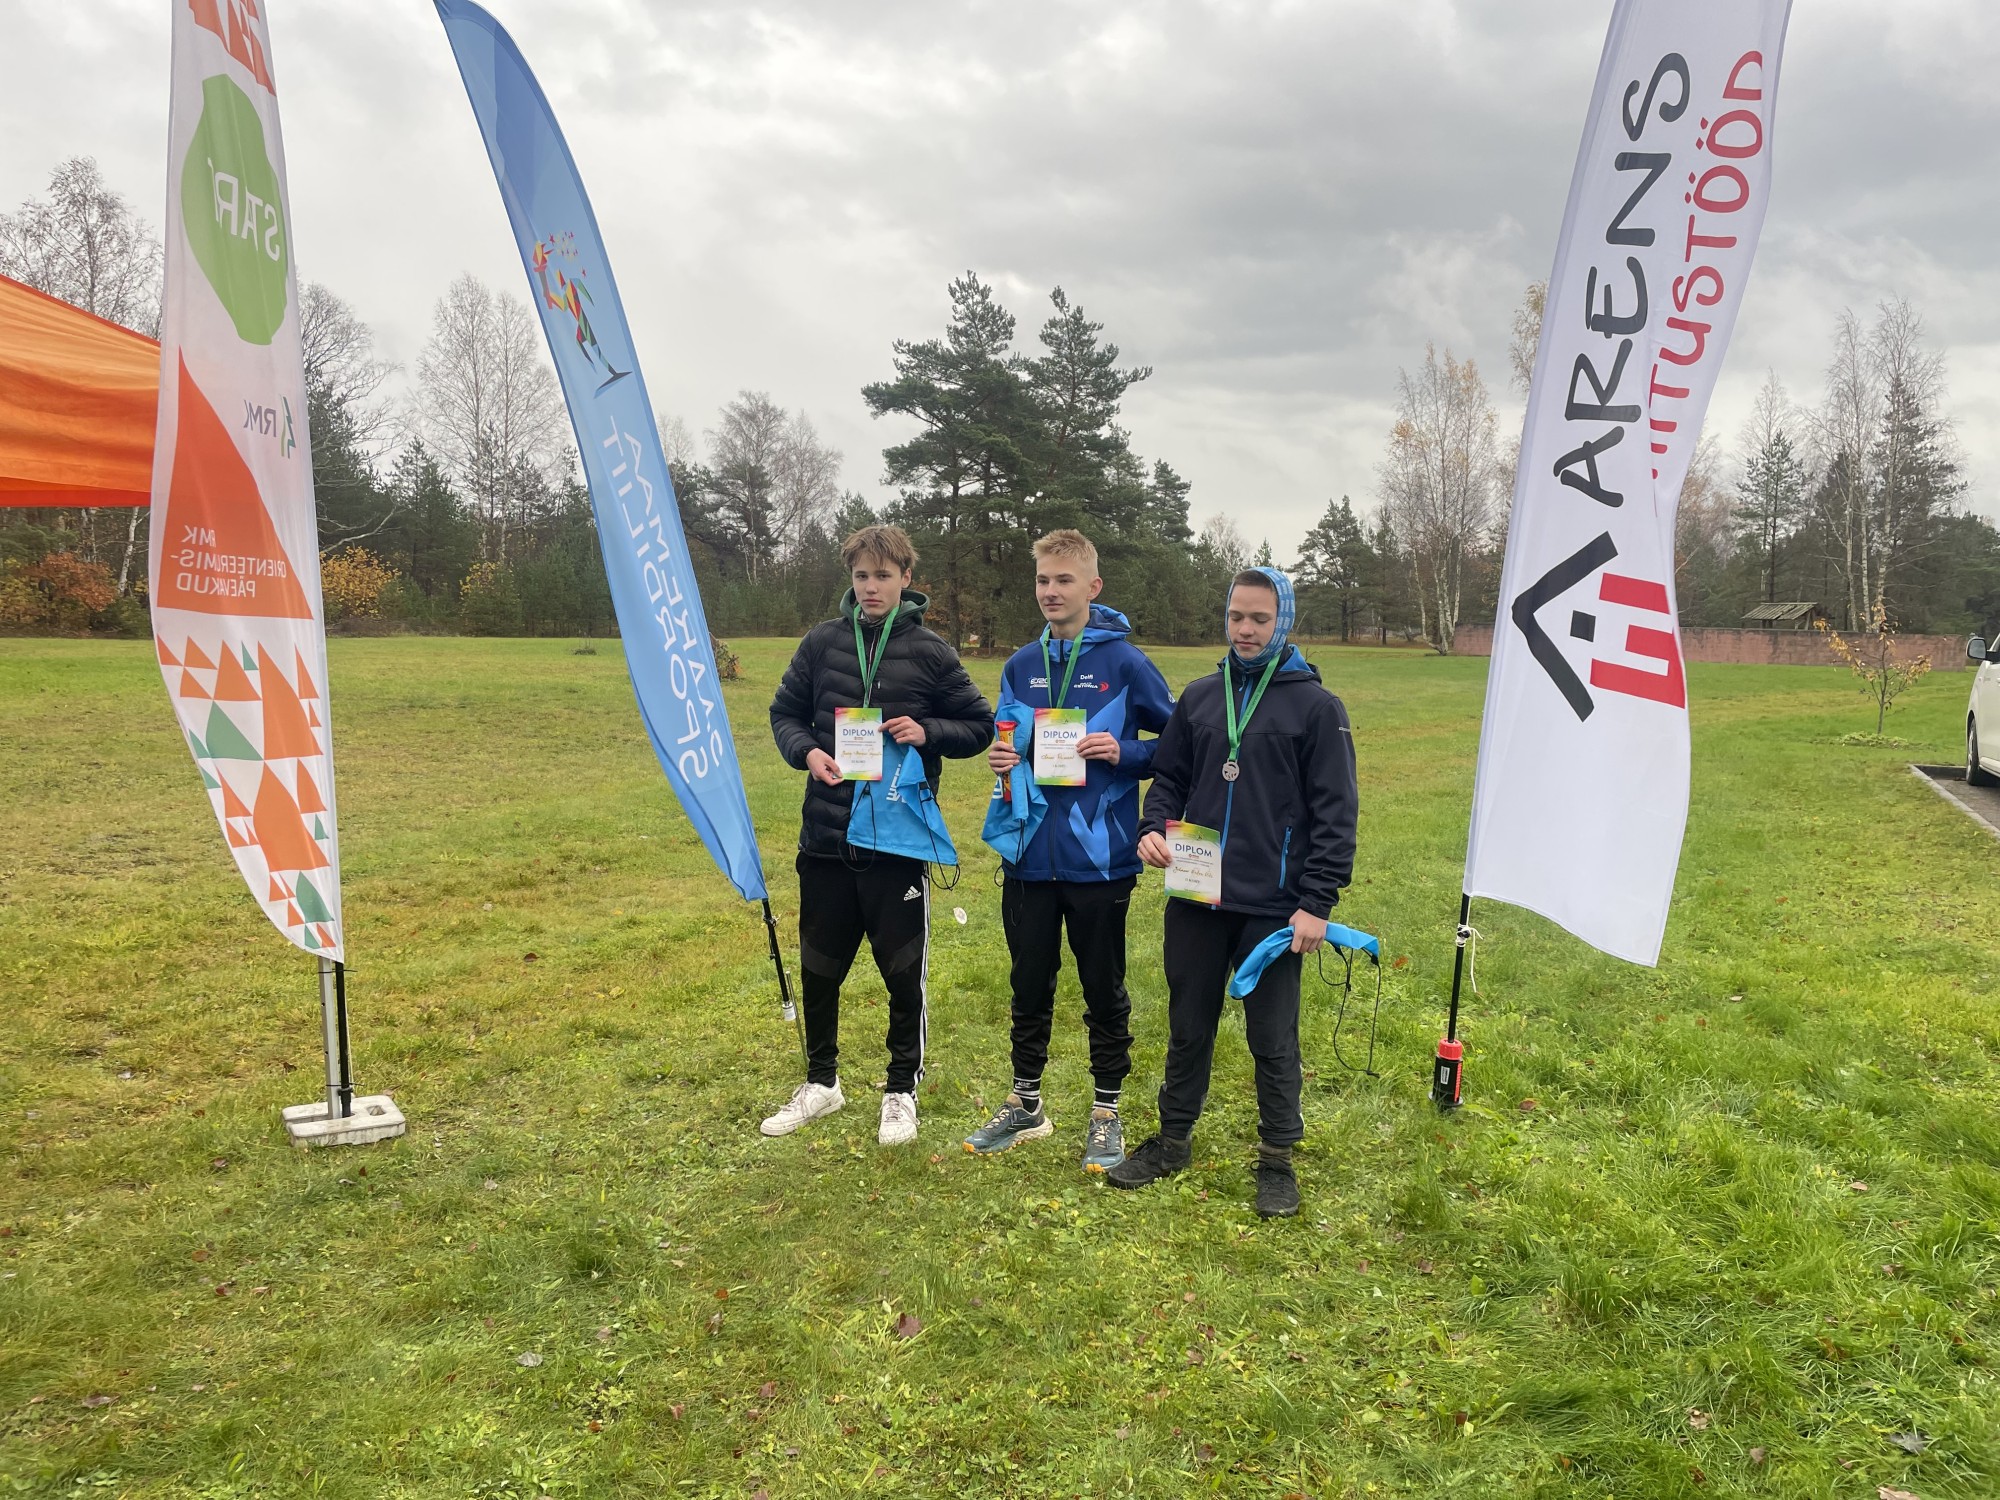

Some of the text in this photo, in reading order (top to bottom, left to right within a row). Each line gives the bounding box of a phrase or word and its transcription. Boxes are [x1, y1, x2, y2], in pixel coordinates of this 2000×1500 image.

[1648, 50, 1764, 481] ITUSTÖÖD
[1553, 52, 1690, 508] ARENS
[842, 728, 875, 737] DIPLOM
[1043, 730, 1078, 739] DIPLOM
[1175, 843, 1213, 858] DIPLOM
